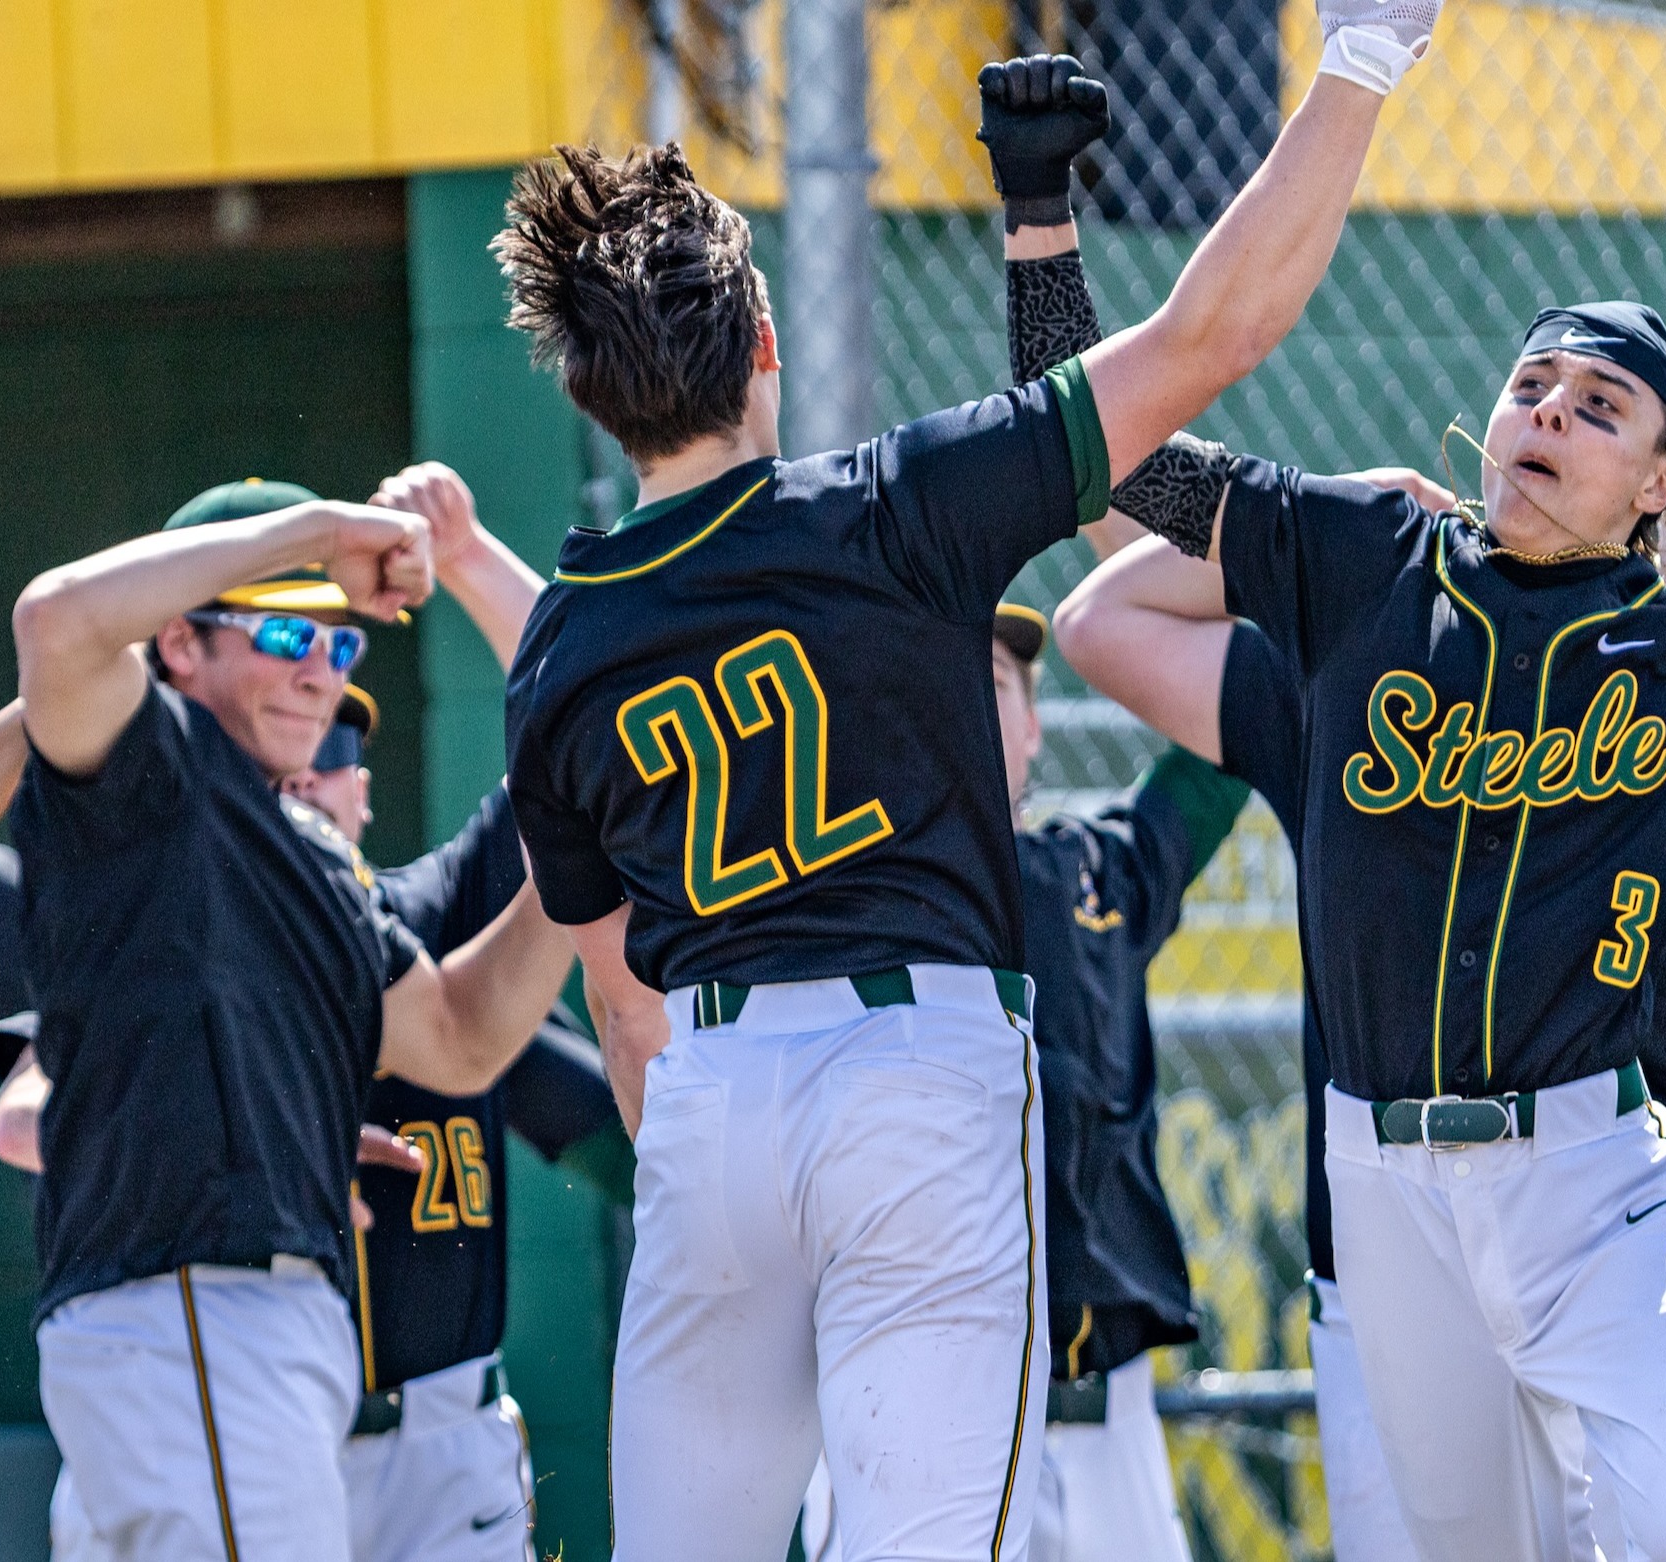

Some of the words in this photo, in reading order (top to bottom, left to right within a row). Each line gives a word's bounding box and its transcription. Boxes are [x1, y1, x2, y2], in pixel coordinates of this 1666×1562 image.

[616, 628, 894, 917] 22
[1592, 869, 1661, 988] 3
[397, 1115, 493, 1233] 26
